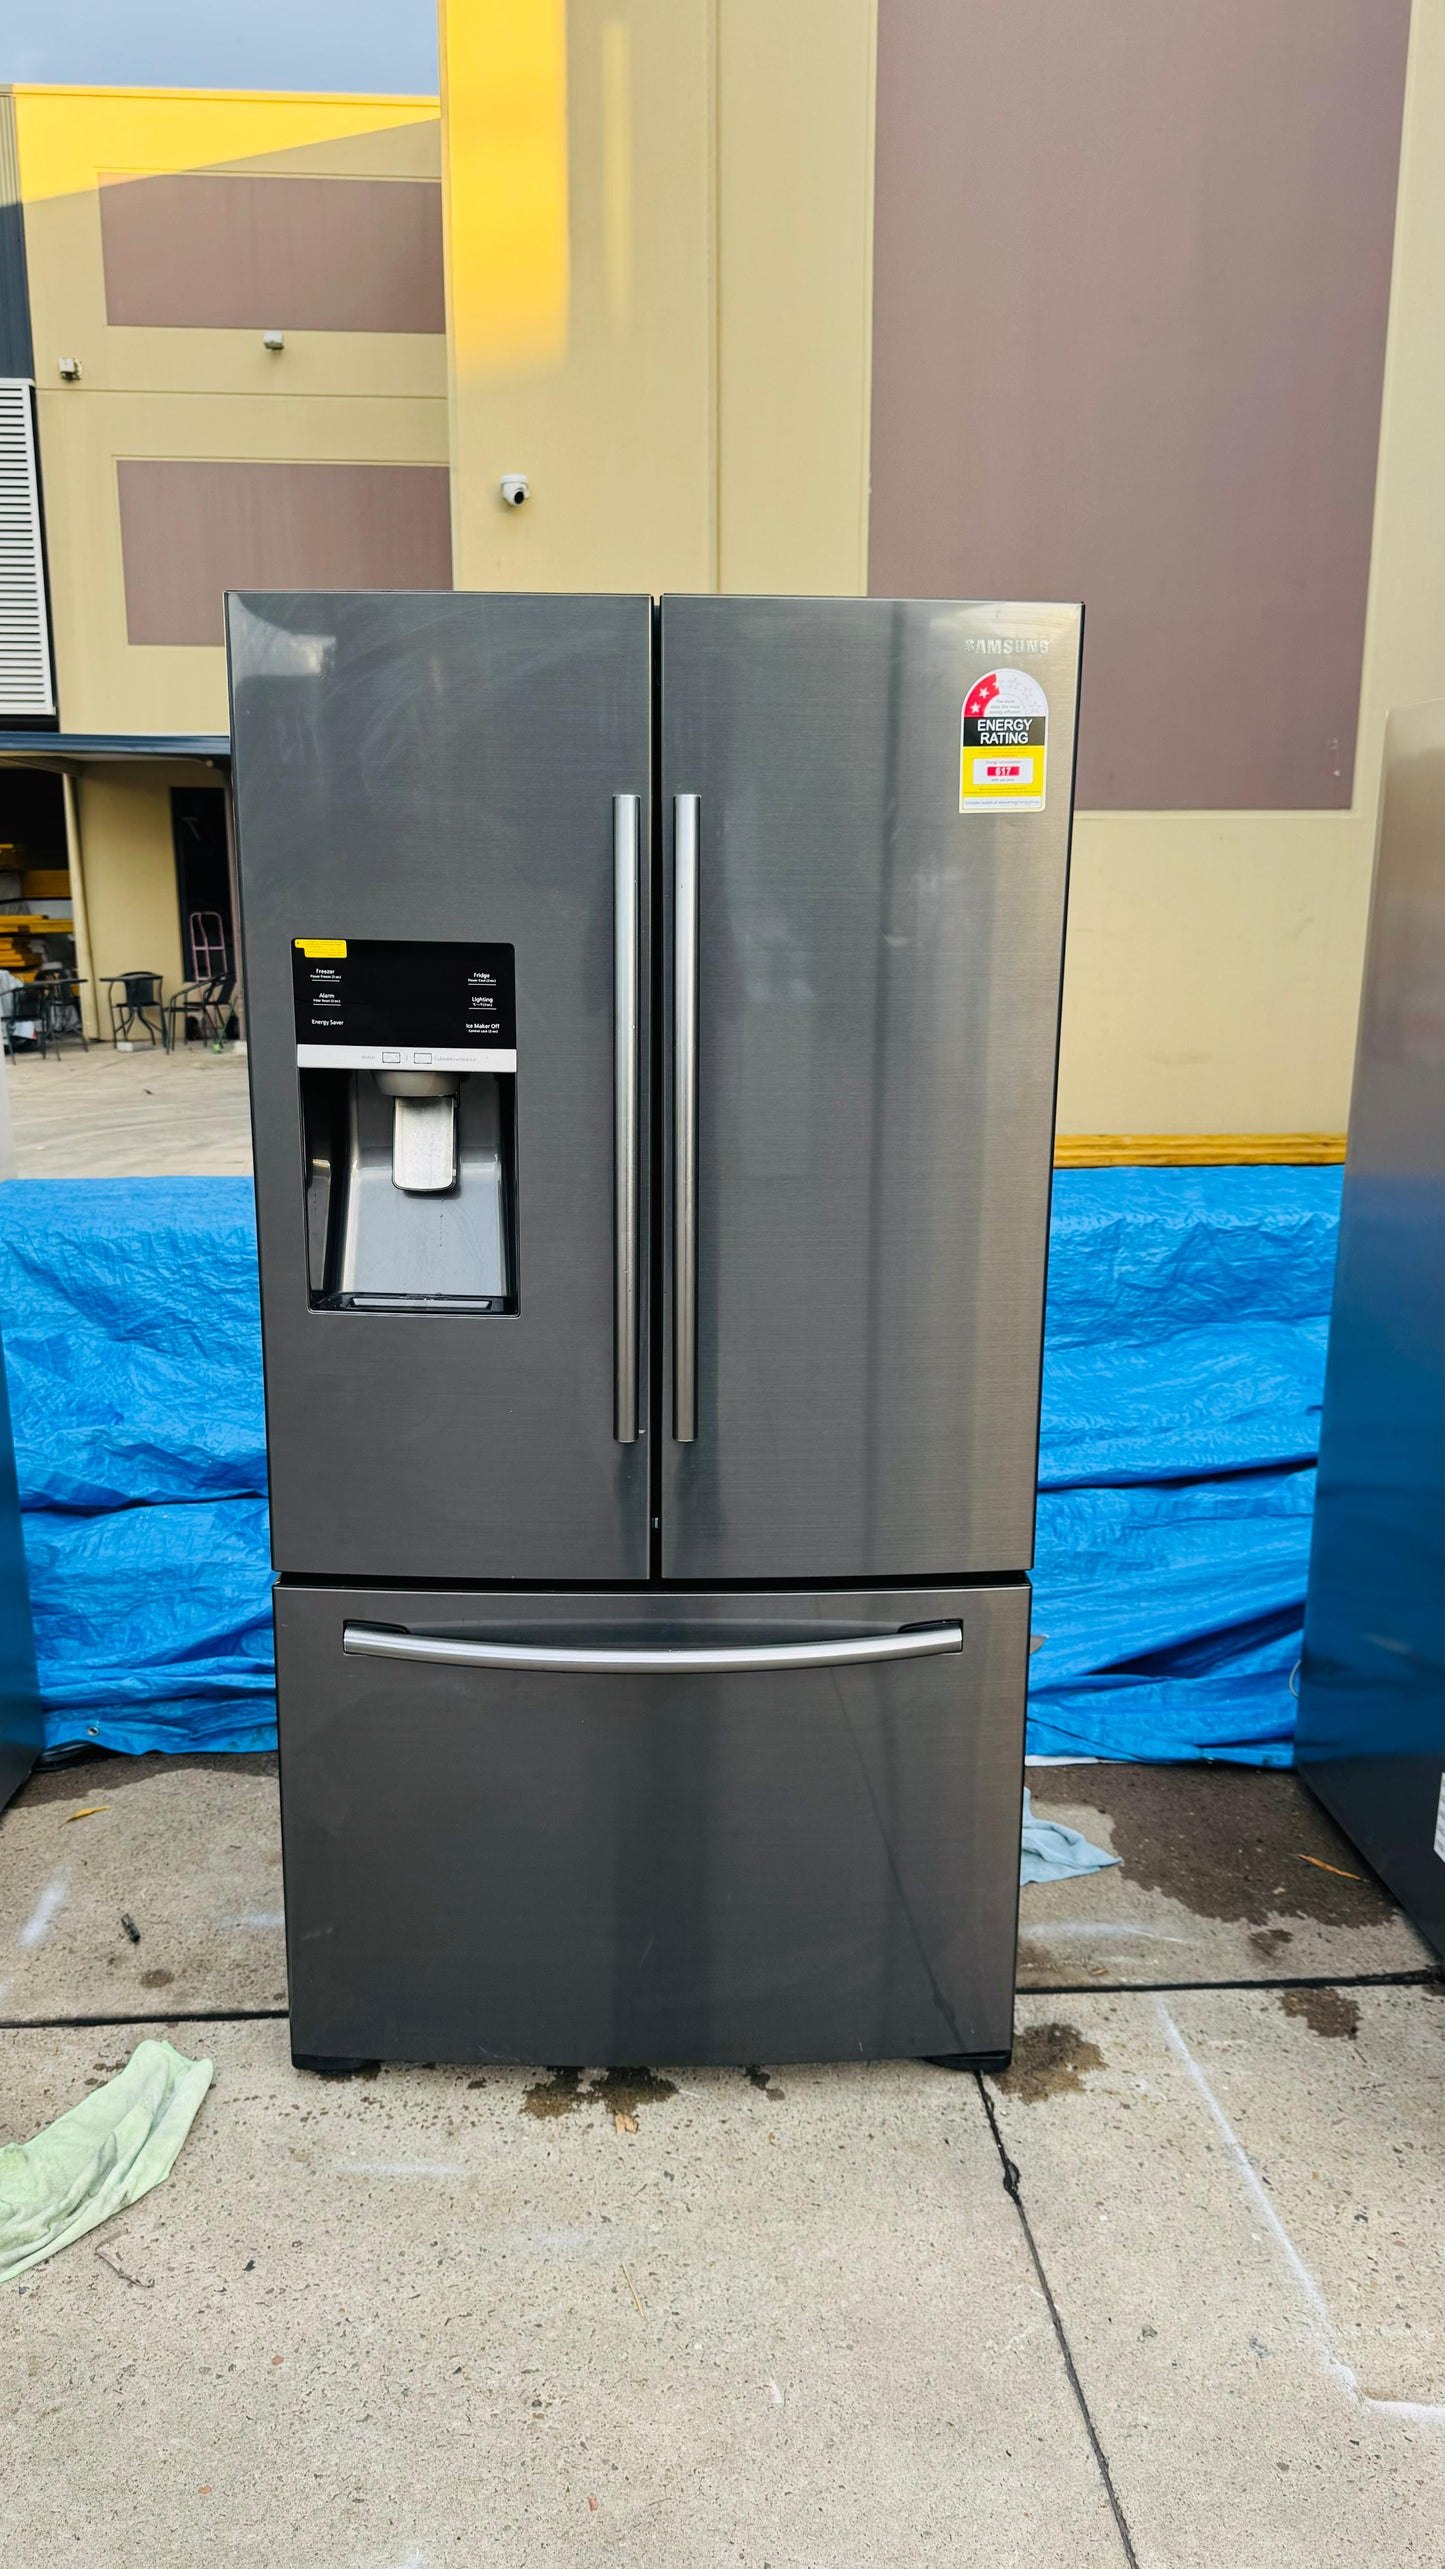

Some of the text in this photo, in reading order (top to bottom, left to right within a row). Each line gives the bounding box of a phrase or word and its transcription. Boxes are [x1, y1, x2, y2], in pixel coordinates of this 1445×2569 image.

[964, 639, 1049, 655] SAMSUNG
[977, 719, 1033, 732] ENERGY
[980, 732, 1029, 744] RATING
[995, 767, 1012, 776] 617
[471, 996, 494, 1004] Lighting
